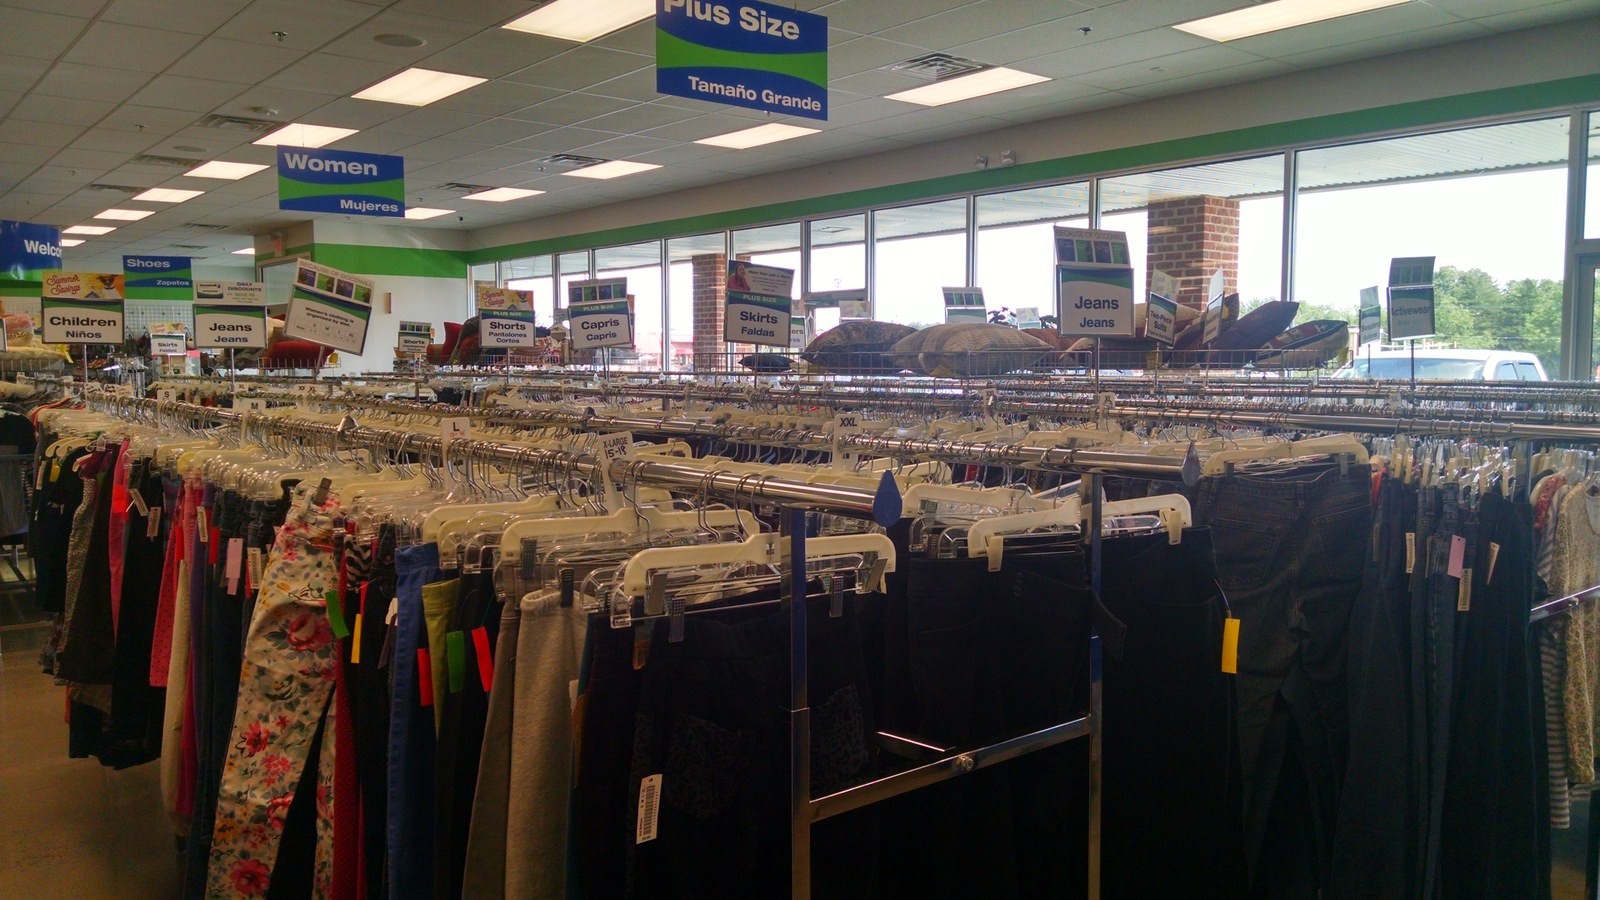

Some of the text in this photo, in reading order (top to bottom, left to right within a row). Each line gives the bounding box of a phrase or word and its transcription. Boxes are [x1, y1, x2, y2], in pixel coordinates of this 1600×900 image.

[664, 0, 800, 40] Plus Size
[688, 75, 822, 112] Tamaño Grande
[284, 152, 378, 176] Women
[340, 199, 399, 213] Mujeres
[126, 258, 171, 268] Shoes
[156, 279, 190, 287] Zapatos
[50, 284, 81, 295] Savings
[1074, 295, 1119, 310] Jeans
[50, 316, 117, 327] Children
[740, 311, 778, 324] Skirts
[1079, 317, 1115, 328] Jeans
[209, 322, 252, 332] Jeans
[490, 321, 526, 330] Shorts
[581, 318, 620, 330] Capris
[65, 330, 102, 339] Niños
[586, 331, 617, 341] Capris
[741, 326, 775, 337] Faldas
[214, 335, 249, 343] Jeans
[251, 402, 259, 410] M
[453, 421, 460, 431] L
[840, 417, 857, 427] XXL
[603, 437, 628, 449] X-LARGE
[604, 445, 627, 459] 15-18
